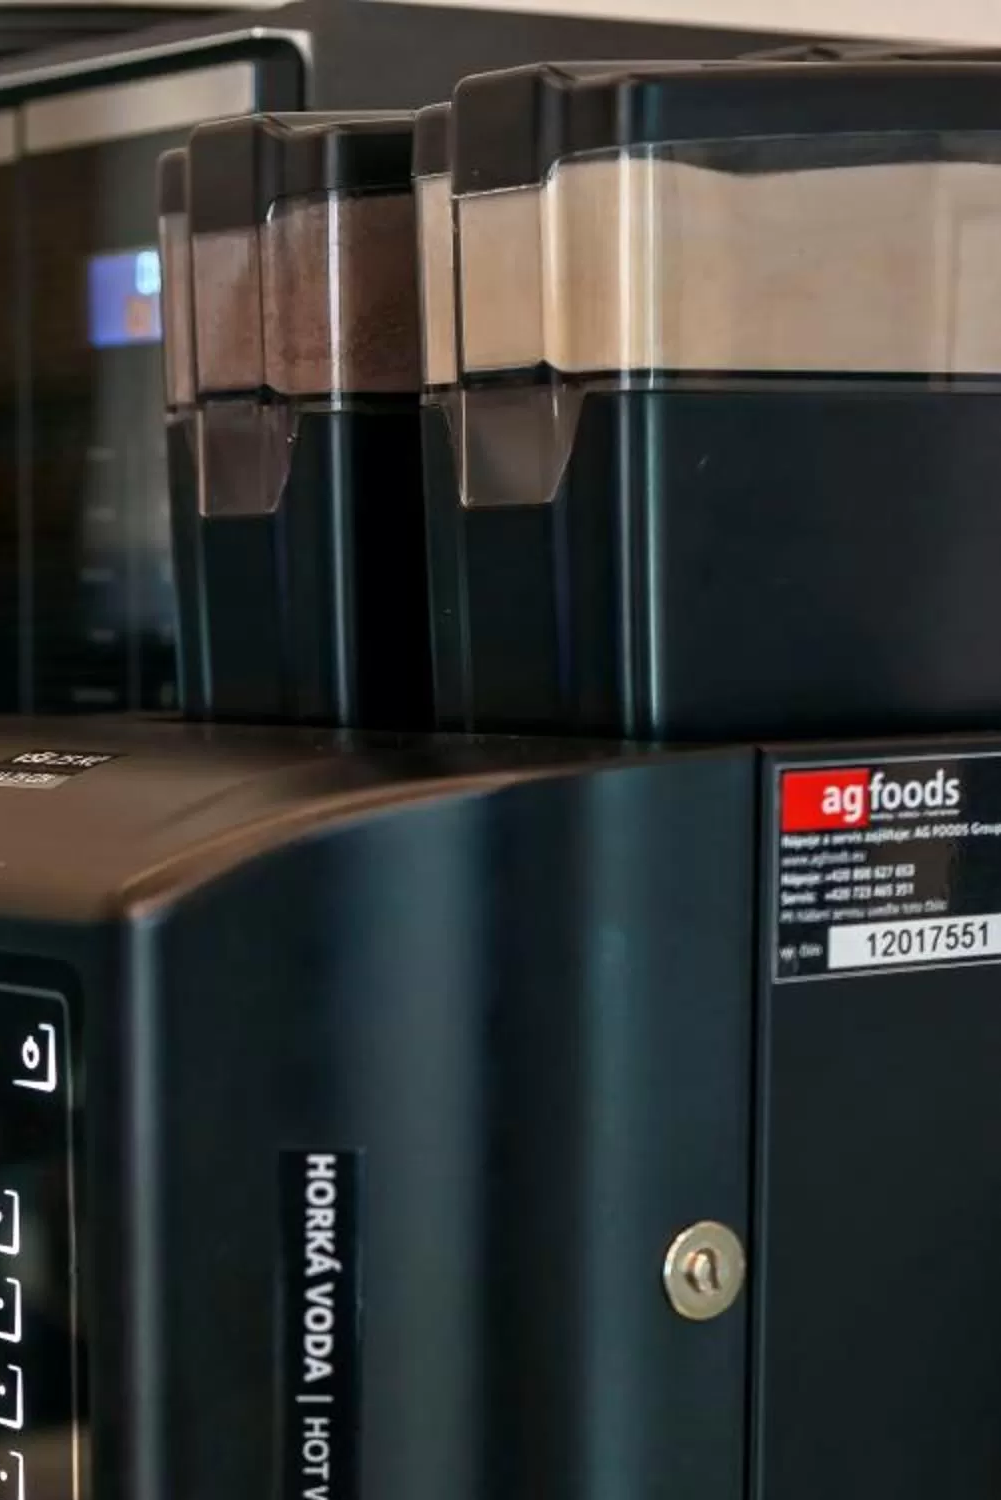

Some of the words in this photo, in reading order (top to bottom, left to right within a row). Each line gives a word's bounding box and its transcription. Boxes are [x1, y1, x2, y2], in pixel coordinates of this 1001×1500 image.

[866, 920, 989, 958] 12017551
[304, 1153, 343, 1277] HORKÁ
[303, 1282, 335, 1383] VODA
[302, 1416, 331, 1481] HOT
